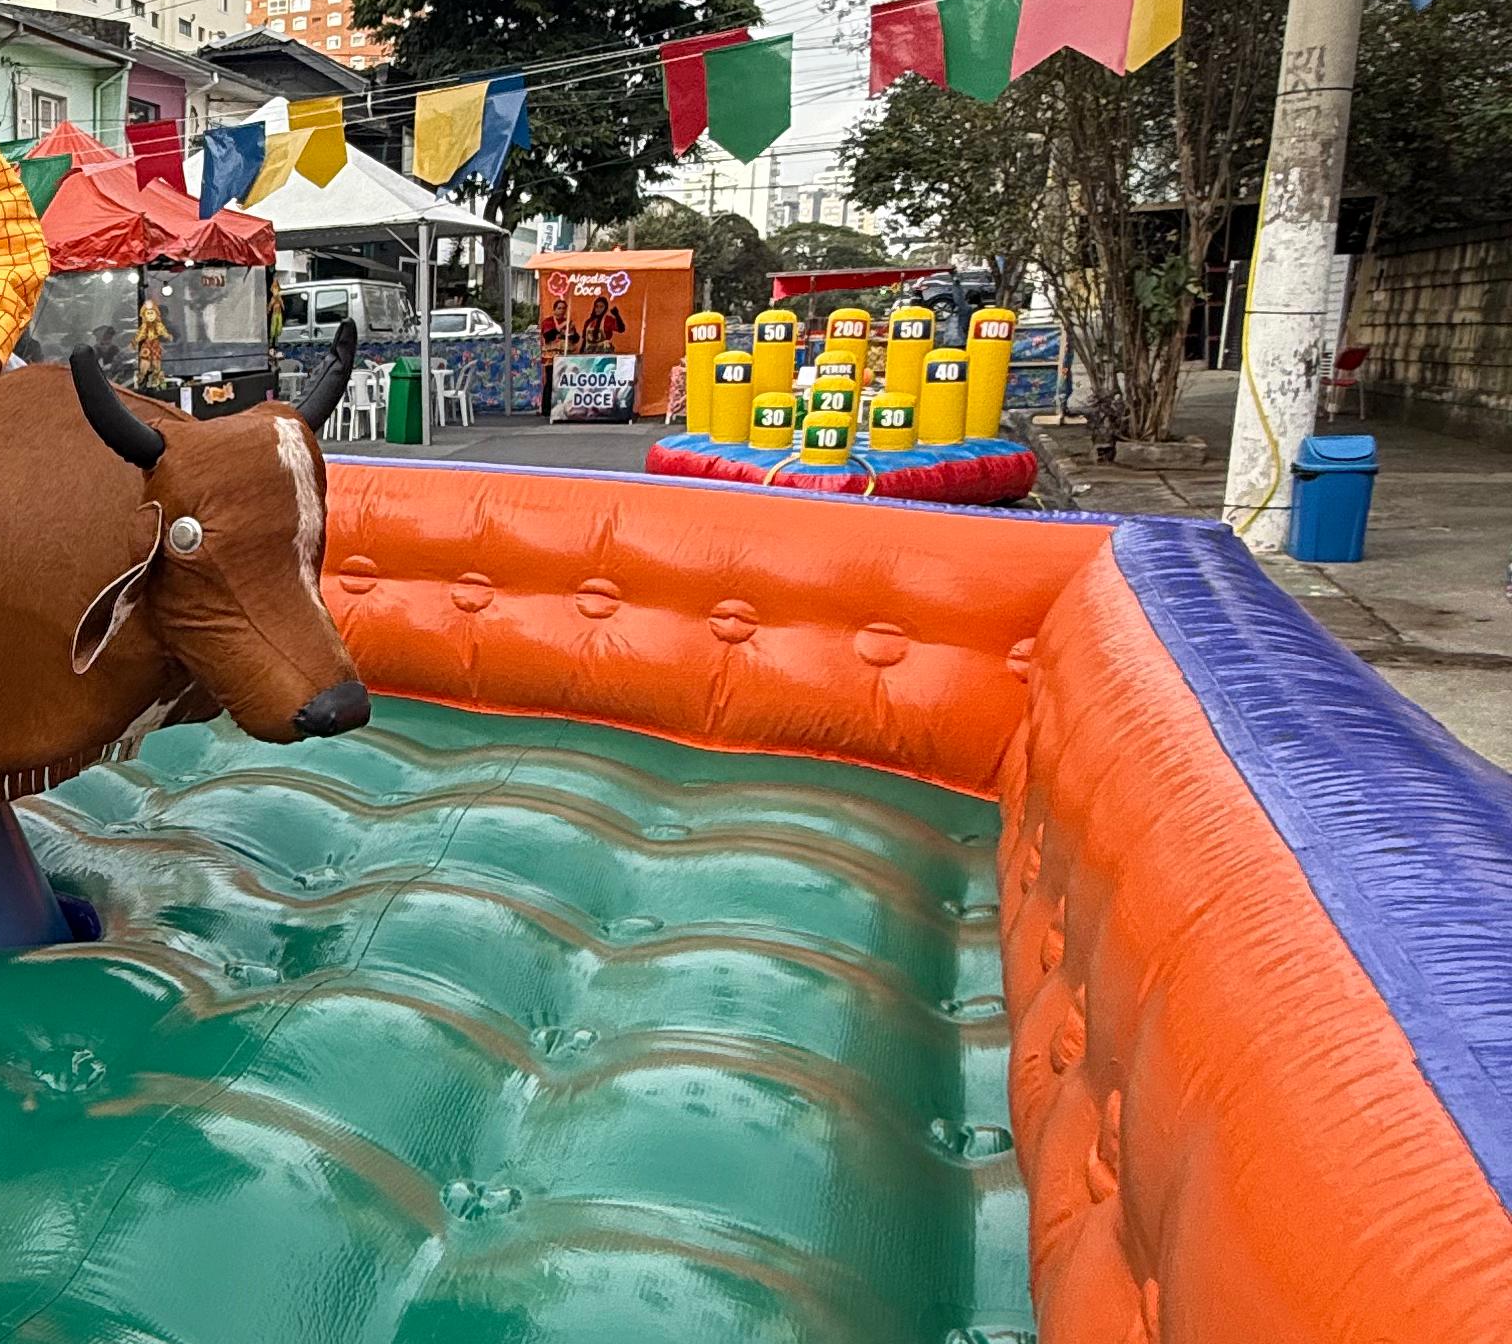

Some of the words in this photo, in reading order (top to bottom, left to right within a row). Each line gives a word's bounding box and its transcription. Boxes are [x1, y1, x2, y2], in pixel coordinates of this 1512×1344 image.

[574, 283, 602, 296] Doce
[690, 324, 717, 341] 100
[763, 324, 786, 340] 50
[833, 321, 864, 337] 200
[899, 321, 924, 338] 50
[980, 321, 1008, 338] 100
[722, 365, 744, 382] 40
[819, 364, 853, 375] PERDE
[935, 363, 959, 381] 40
[574, 393, 611, 406] DOCE
[820, 392, 845, 410] 20
[761, 409, 785, 426] 30
[880, 409, 905, 427] 30
[816, 429, 838, 447] 10
